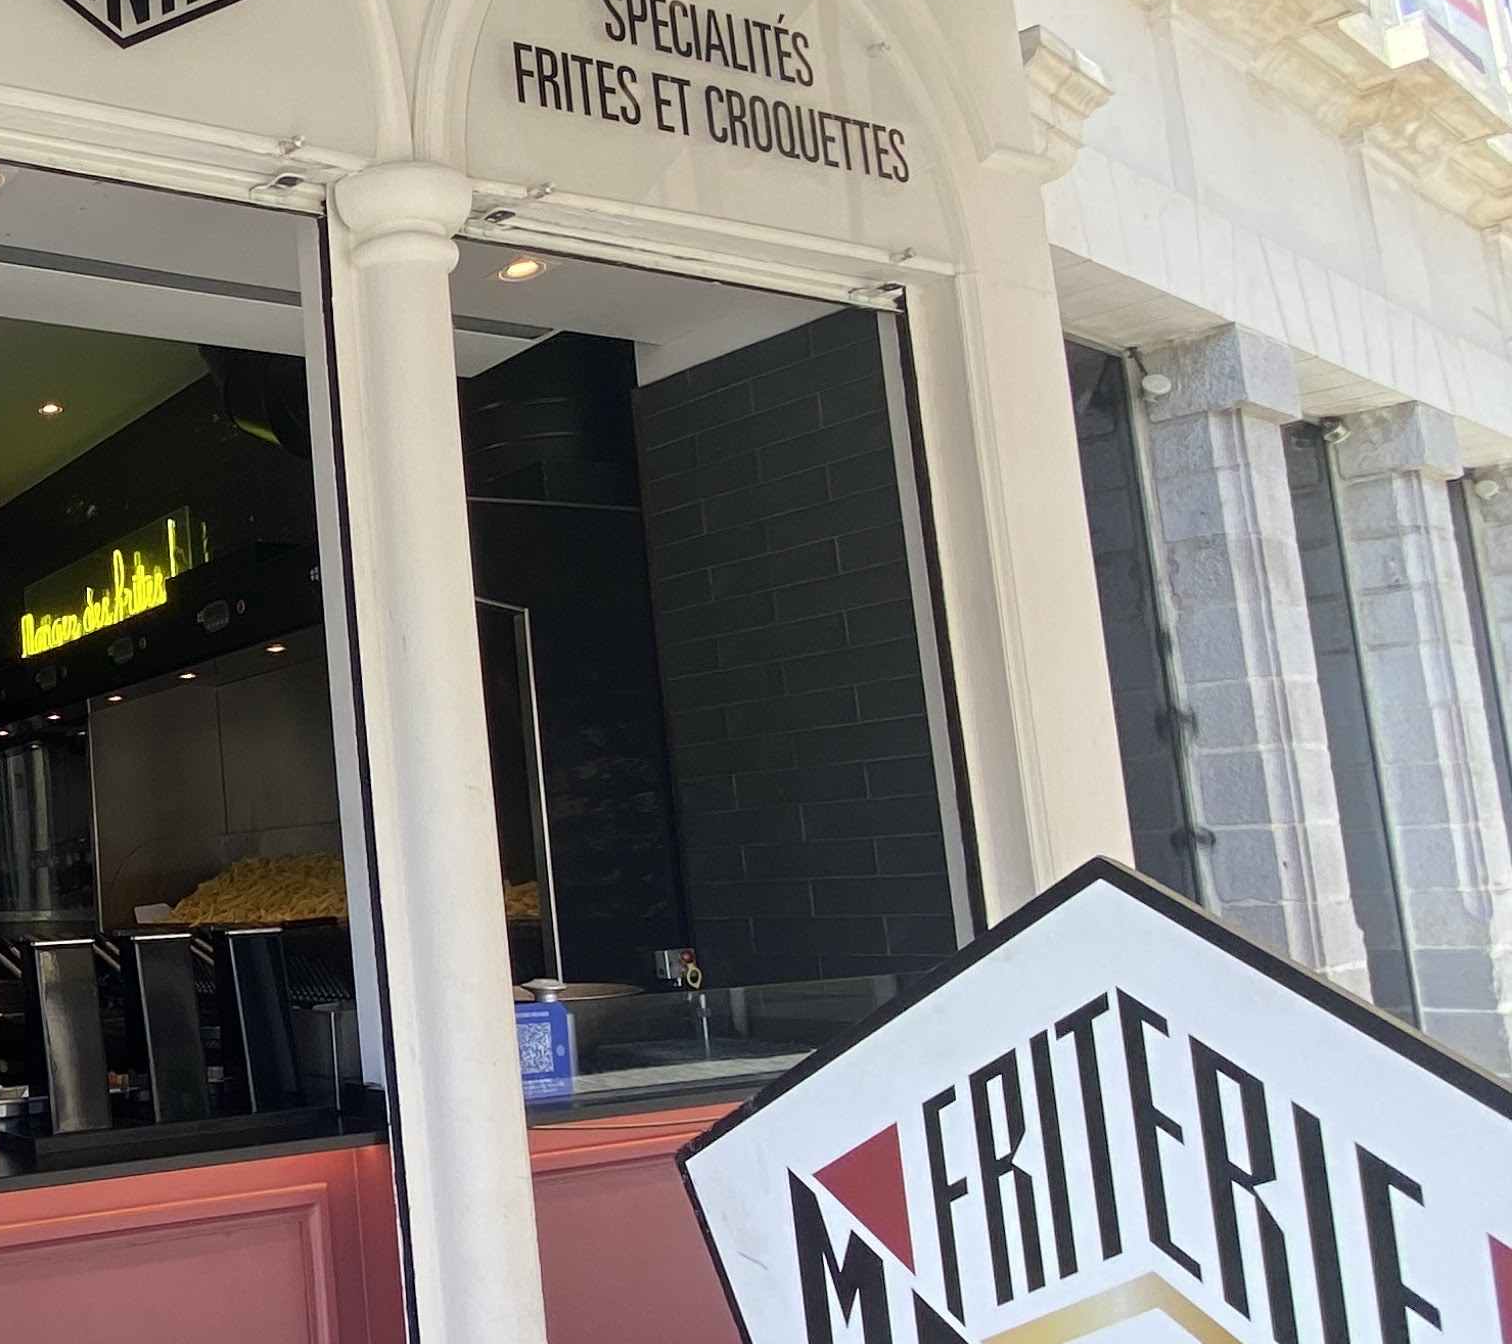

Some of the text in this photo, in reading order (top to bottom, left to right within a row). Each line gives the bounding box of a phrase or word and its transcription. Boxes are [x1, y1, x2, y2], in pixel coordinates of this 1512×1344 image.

[513, 41, 909, 183] FRITES ET CROQUETTES
[82, 586, 111, 633] des
